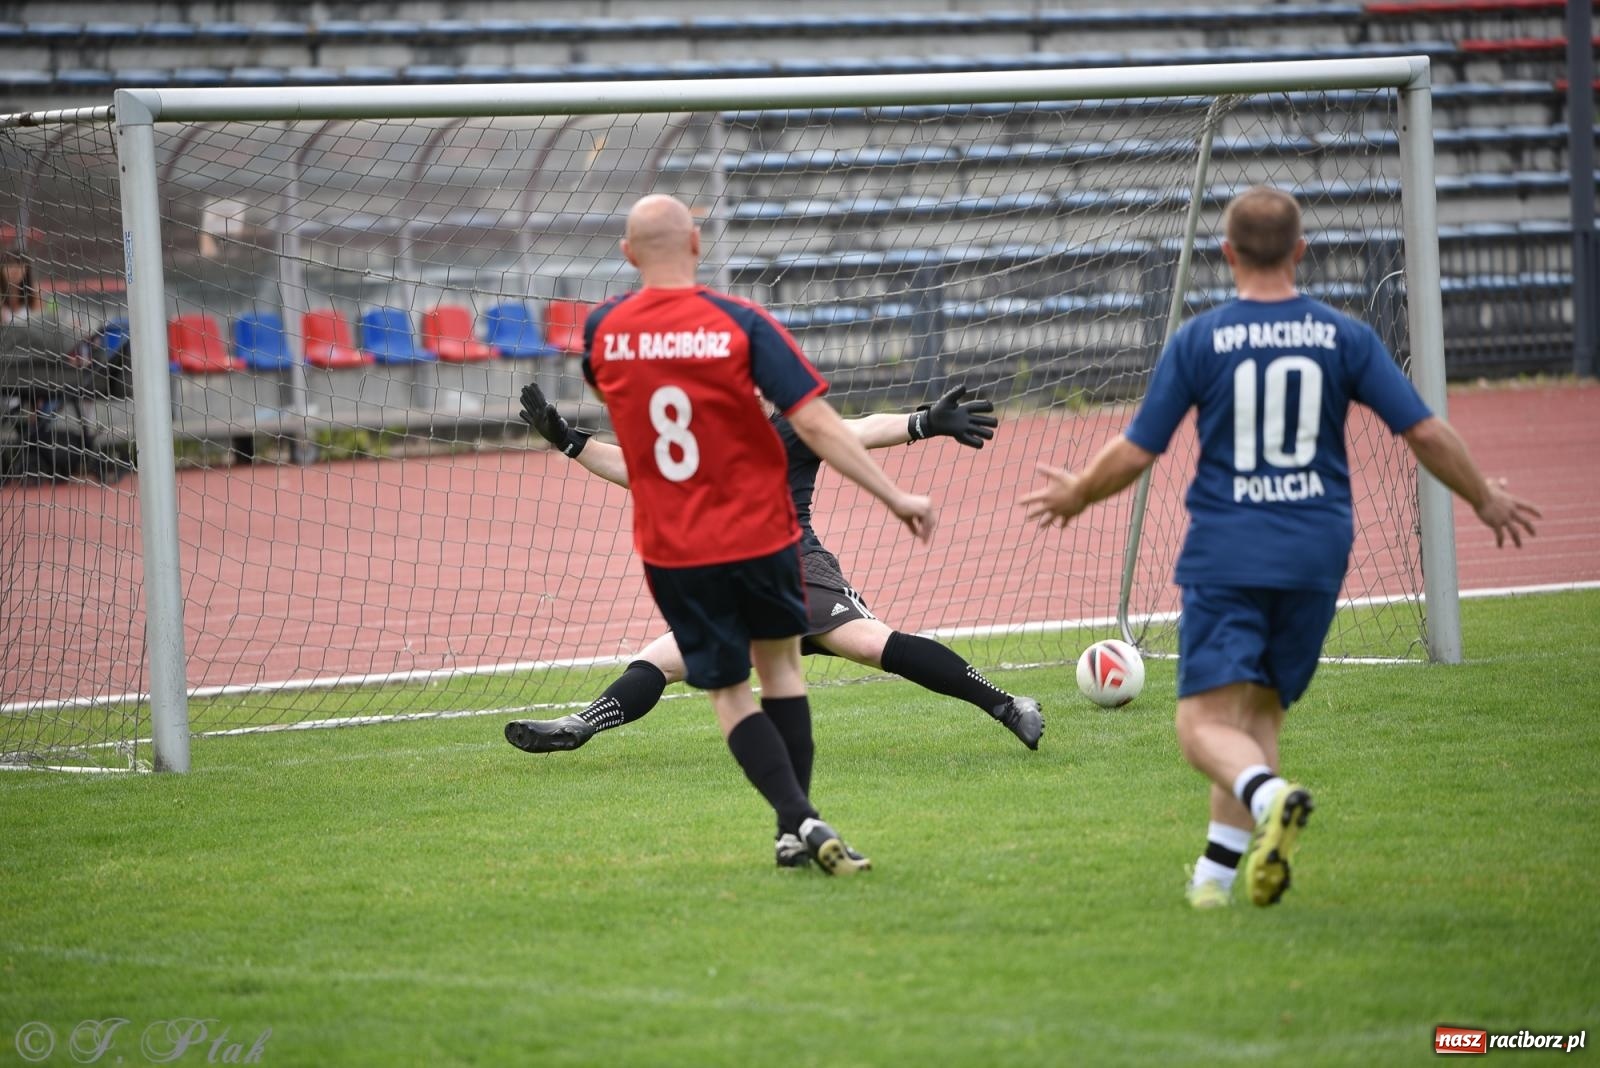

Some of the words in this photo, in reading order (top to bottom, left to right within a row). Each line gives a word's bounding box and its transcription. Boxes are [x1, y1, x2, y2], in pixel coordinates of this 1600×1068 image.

[603, 333, 636, 361] Z.K.
[638, 326, 732, 359] RACIBÓRZ
[1213, 324, 1248, 353] KPP
[1249, 313, 1337, 350] RACIBÓRZ
[648, 384, 700, 482] 8
[1233, 355, 1323, 472] 10
[1233, 470, 1325, 503] POLICJA
